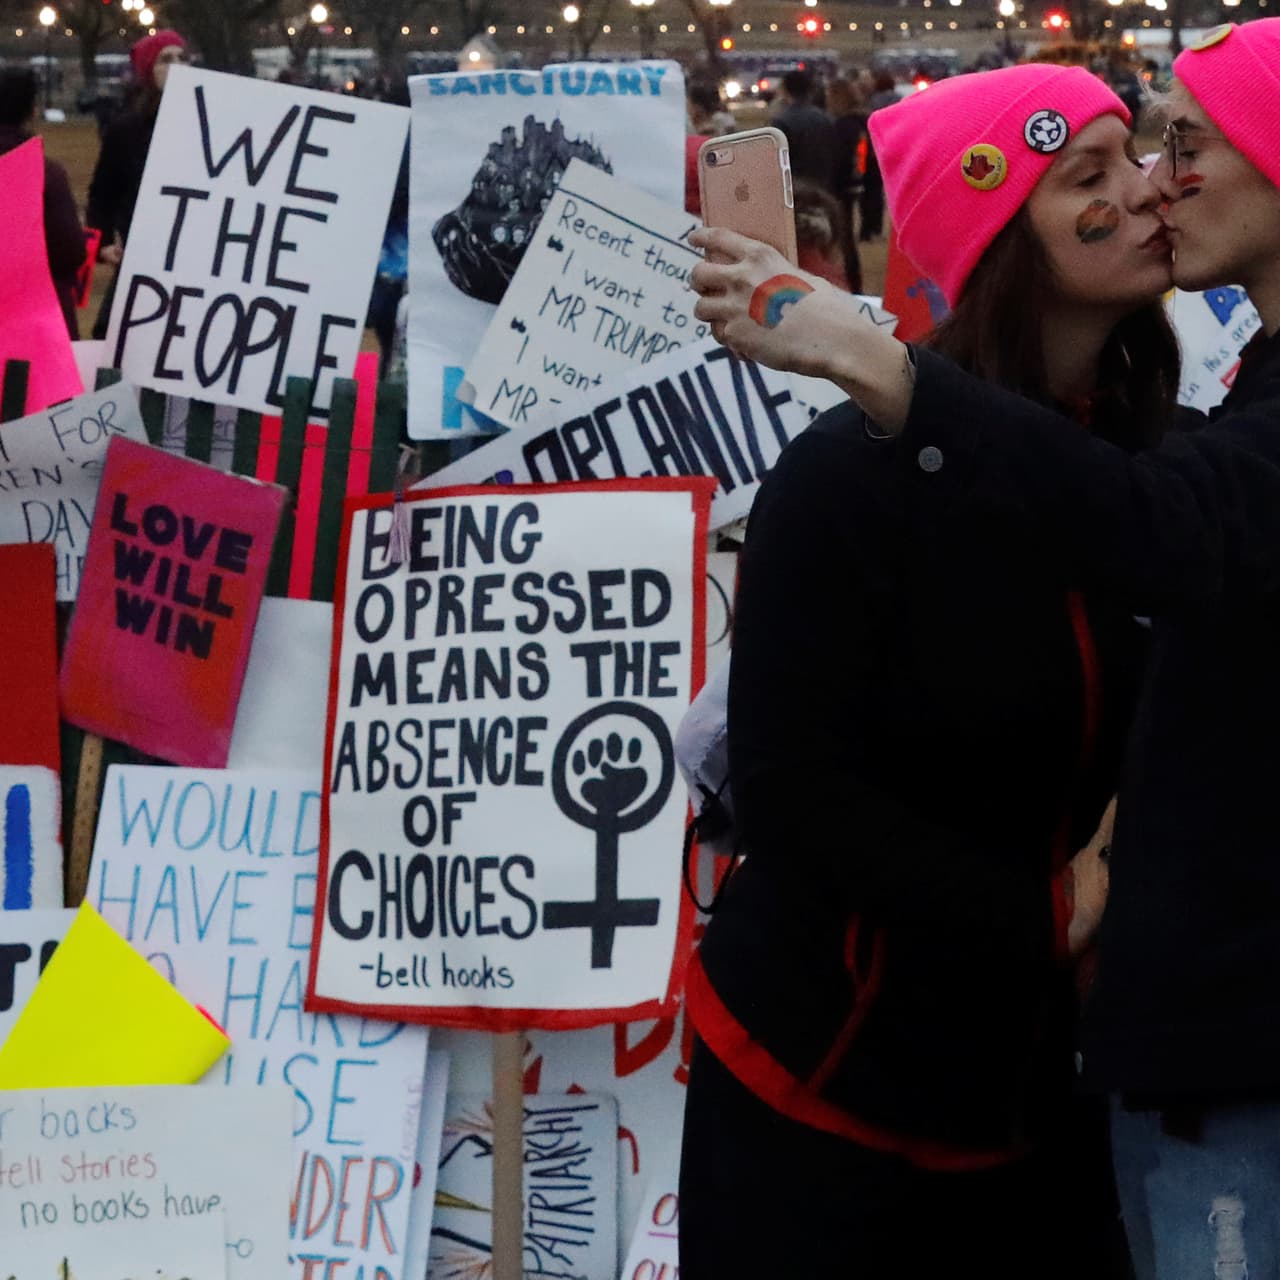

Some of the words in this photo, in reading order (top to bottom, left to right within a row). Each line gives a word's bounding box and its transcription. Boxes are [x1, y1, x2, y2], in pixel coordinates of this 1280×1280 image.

[428, 66, 668, 98] SANCTUARY
[194, 85, 356, 205] WE
[160, 185, 329, 294] THE
[556, 198, 635, 258] Recent
[537, 286, 586, 333] MR
[583, 267, 646, 309] want
[661, 302, 690, 330] to
[113, 273, 357, 419] PEOPLE
[542, 353, 603, 392] want
[48, 400, 128, 452] FOR
[488, 377, 538, 423] MR
[108, 491, 255, 575] LOVE
[362, 500, 543, 581] BEING
[112, 538, 234, 619] WILL
[354, 568, 672, 644] OPRESSED
[112, 587, 216, 661] WIN
[348, 641, 551, 709] MEANS
[570, 640, 681, 699] THE
[330, 714, 552, 795] ABSENCE
[117, 774, 322, 858] WOULD
[402, 791, 477, 849] OF
[97, 859, 269, 947] HAVE
[327, 848, 539, 942] CHOICES
[442, 951, 515, 991] hooks
[38, 1097, 138, 1141] backs
[19, 1199, 60, 1229] no
[72, 1189, 151, 1224] books
[522, 1103, 600, 1280] PATRIARCHY
